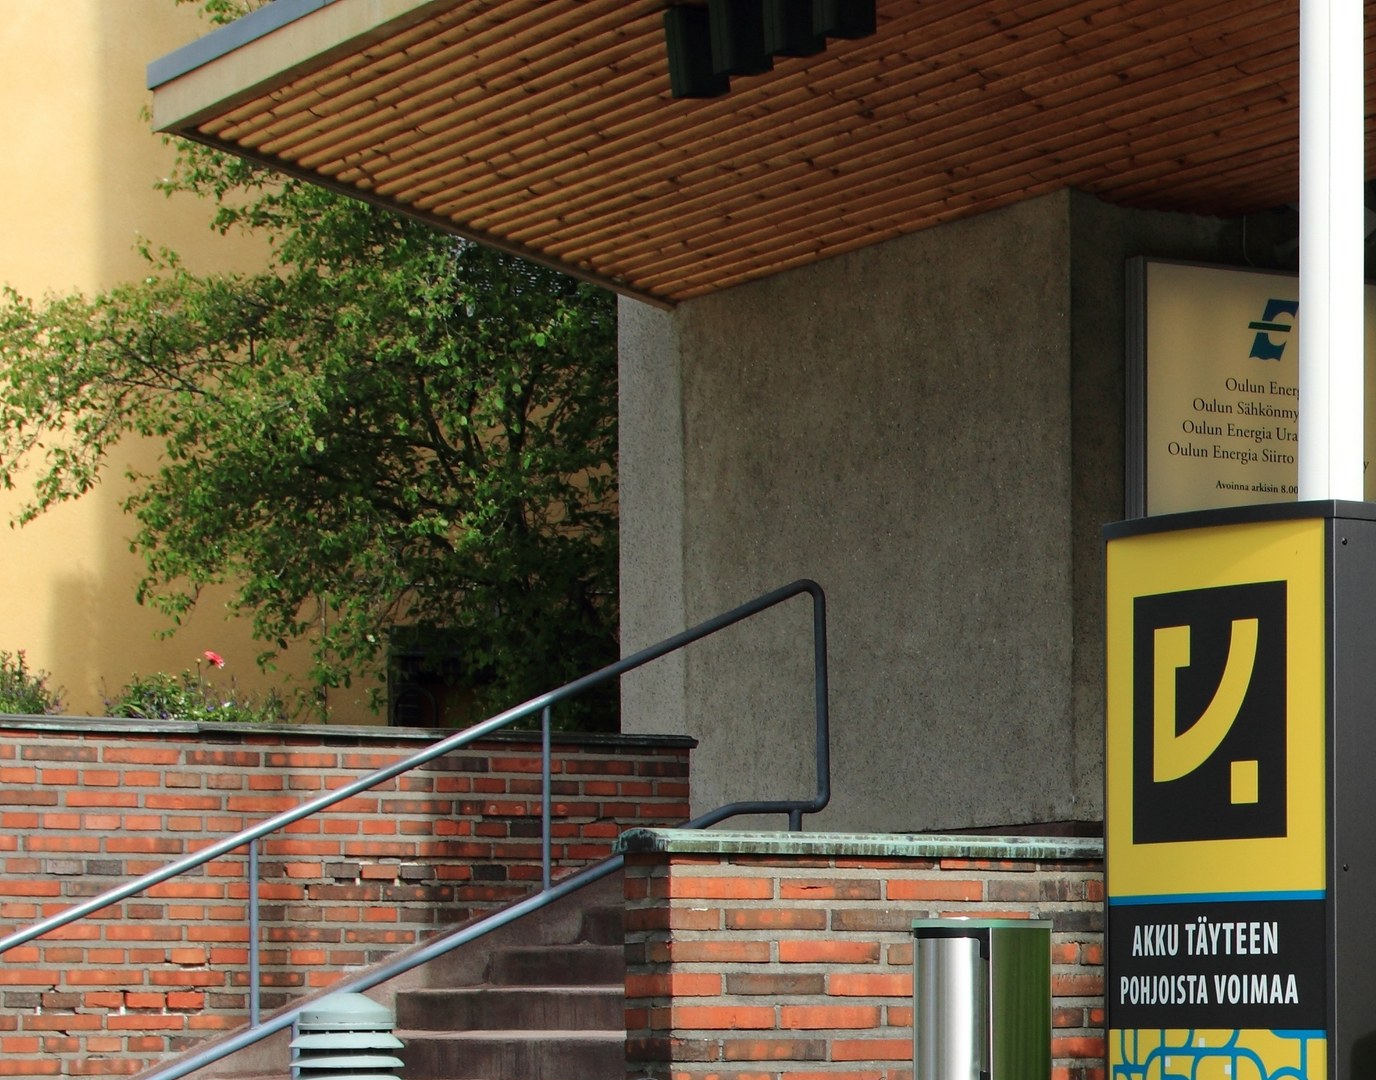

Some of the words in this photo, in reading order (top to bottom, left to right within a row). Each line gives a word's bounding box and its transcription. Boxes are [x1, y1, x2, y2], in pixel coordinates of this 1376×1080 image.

[1225, 377, 1265, 394] Oulun
[1192, 397, 1233, 414] Oulun
[1237, 401, 1299, 423] Sähkönmy
[1182, 419, 1222, 436] Oulun
[1227, 423, 1272, 443] Energia
[1276, 427, 1299, 442] Ura
[1168, 441, 1208, 458] Oulun
[1213, 445, 1258, 465] Energia
[1261, 449, 1294, 465] Siirto
[1216, 480, 1249, 492] Avoinna
[1251, 482, 1279, 493] arkisin
[1132, 924, 1179, 956] AKKU
[1185, 916, 1278, 955] TÄYTEEN
[1120, 974, 1208, 1004] POHJOISTA
[1214, 974, 1299, 1004] VOIMAA
